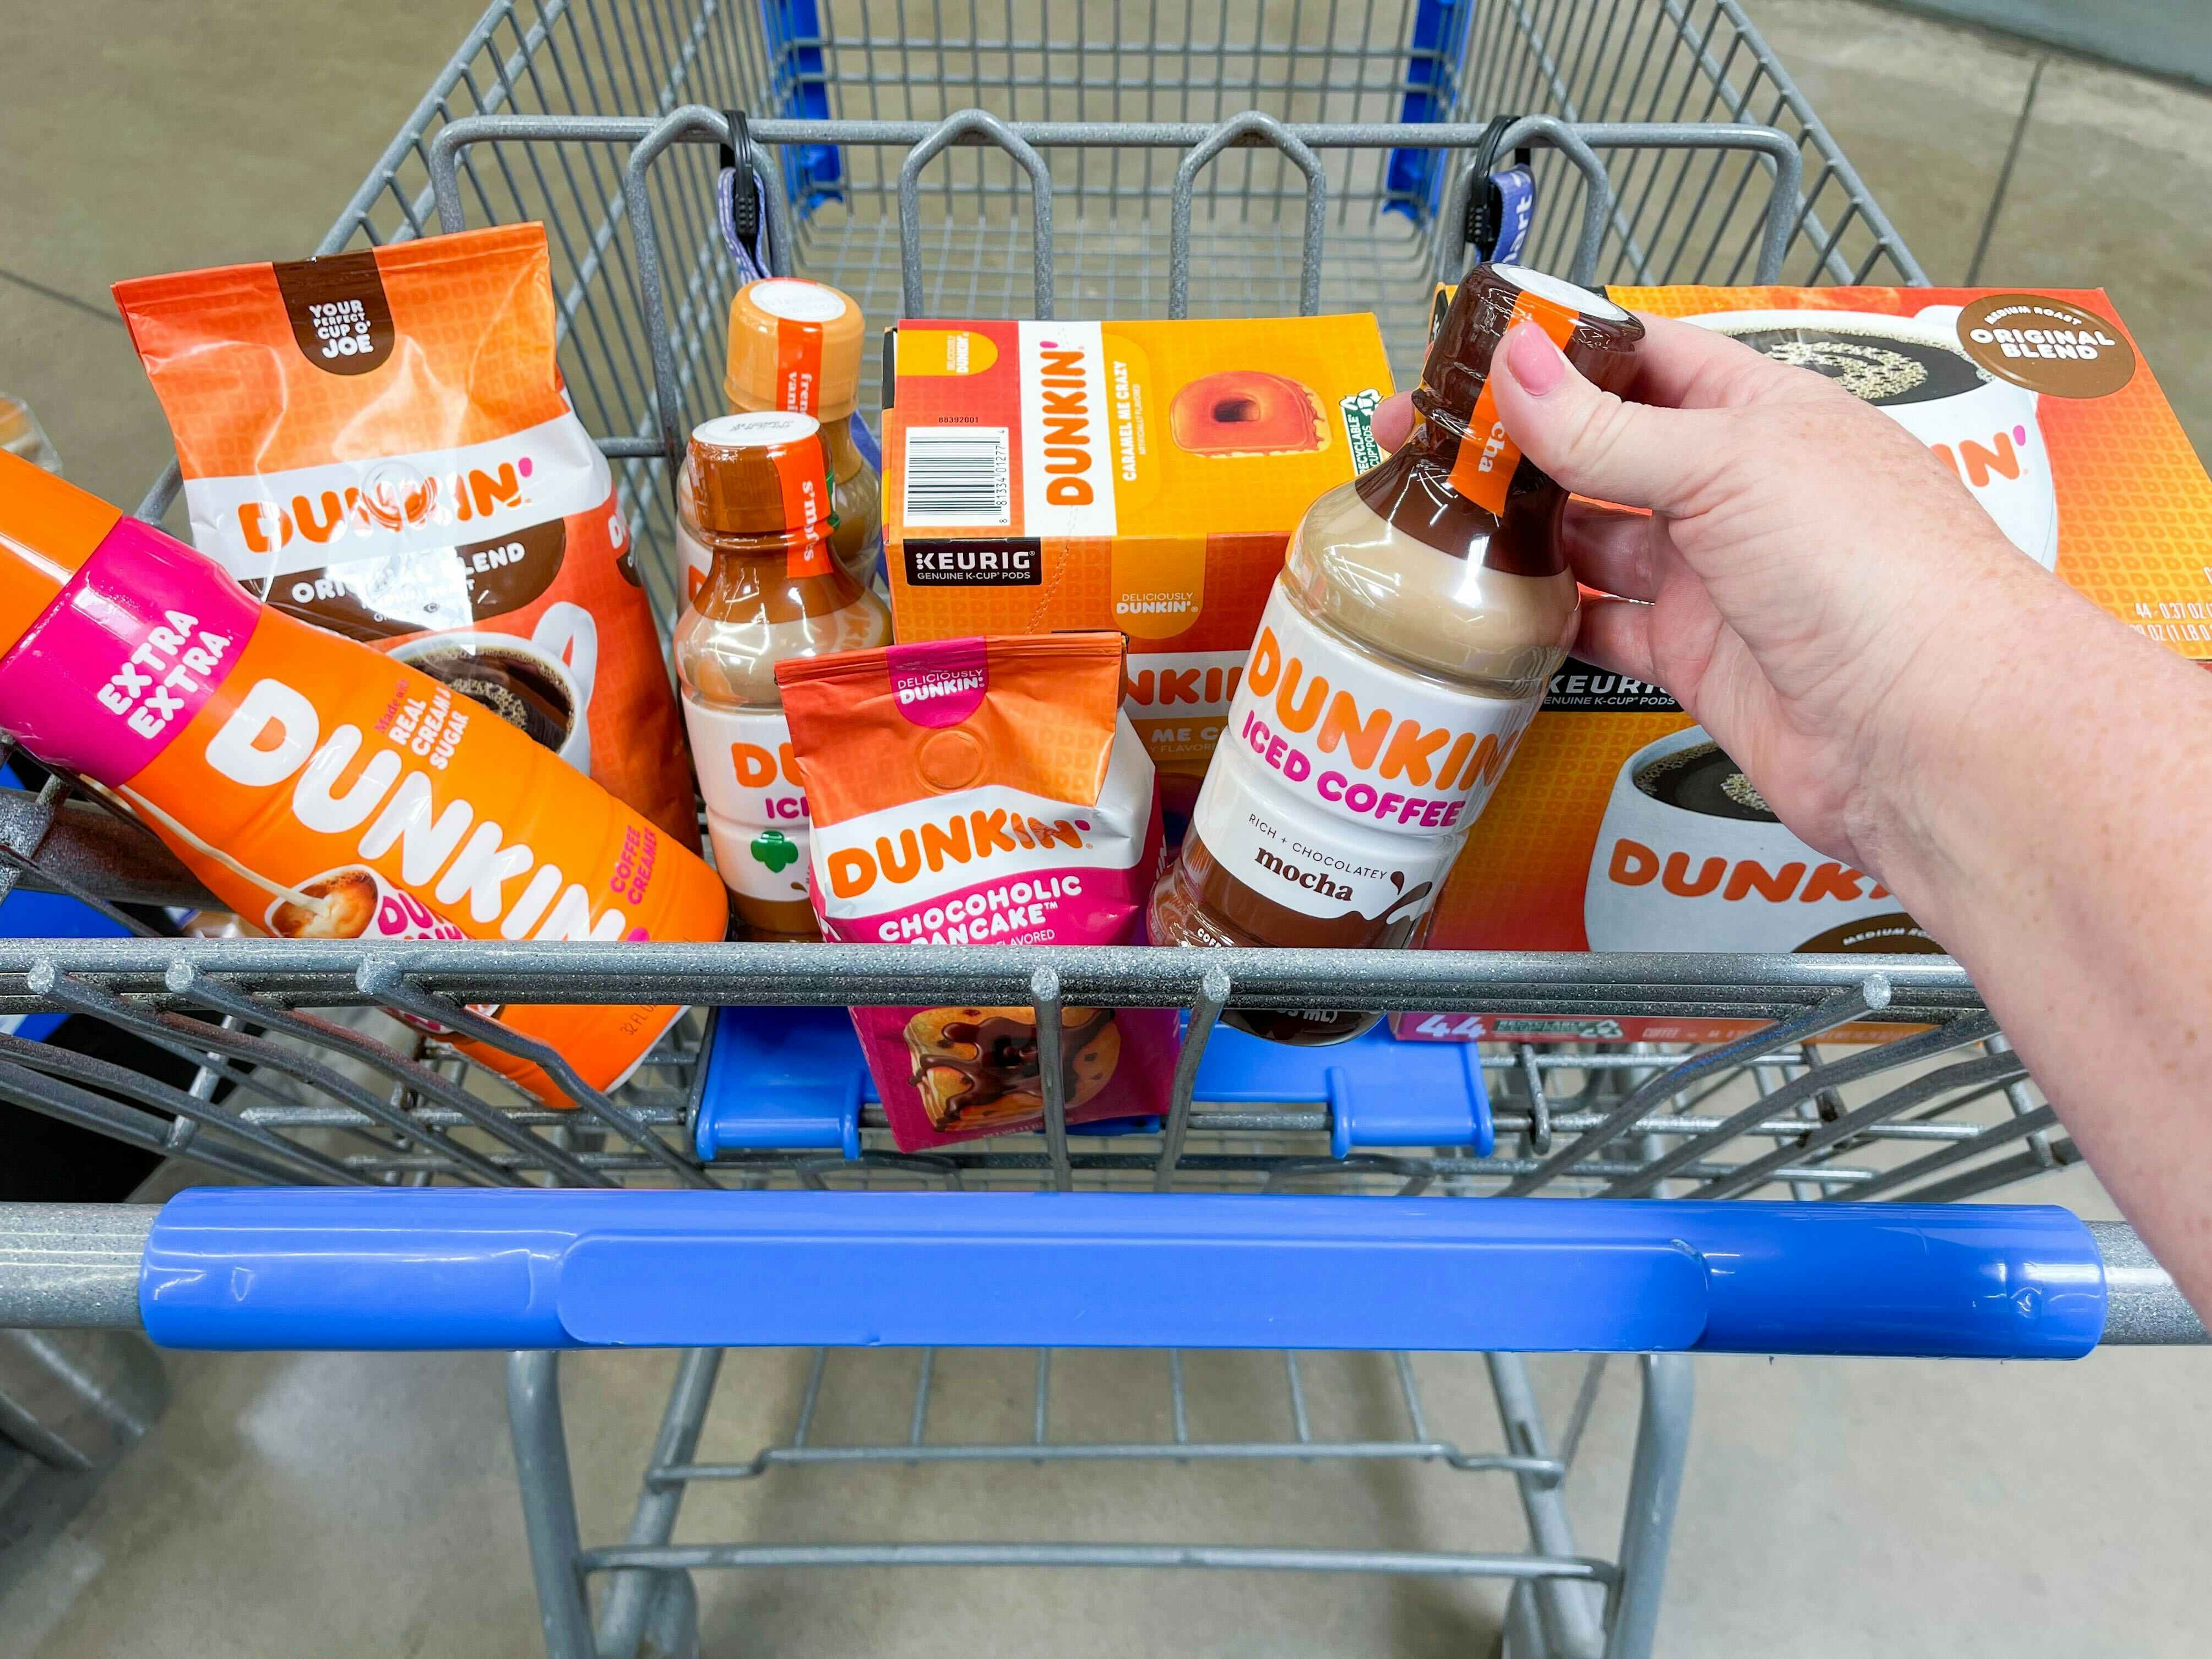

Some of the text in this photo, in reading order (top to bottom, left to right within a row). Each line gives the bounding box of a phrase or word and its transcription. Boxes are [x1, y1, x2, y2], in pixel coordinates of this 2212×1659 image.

[308, 299, 364, 318] YOUR
[313, 312, 366, 328] PERFECT
[1983, 306, 2083, 325] MEDIUM ROAST
[317, 320, 371, 340] CUP O'
[1970, 329, 2116, 346] ORIGINAL
[322, 334, 374, 358] JOE
[2000, 343, 2099, 360] BLEND
[1040, 340, 1094, 505] DUNKIN'
[1113, 361, 1137, 481] CARAMEL ME CRAZY
[1362, 425, 1376, 447] PODS
[995, 445, 1007, 473] 01277
[996, 477, 1007, 505] 81334
[917, 572, 964, 580] GENUINE
[1002, 571, 1031, 579] PODS
[1122, 592, 1193, 602] DELICIOUSLY
[2186, 602, 2208, 619] OZ
[96, 610, 199, 715] EXTRA
[127, 630, 232, 739] EXTRA
[898, 669, 983, 689] DELICIOUSLY
[1639, 697, 1676, 705] PODS
[388, 698, 427, 746] REAL
[411, 695, 451, 756] CREAM
[1151, 728, 1193, 743] ME
[429, 710, 470, 770] SUGAR
[1242, 710, 1466, 828] ICED COFFEE
[609, 825, 641, 894] COFFEE
[828, 808, 1094, 899] DUNKIN'
[1248, 813, 1277, 839] RICH
[1292, 842, 1388, 880] CHOCOLATEY
[626, 826, 657, 905] CREAMER
[1254, 847, 1354, 901] mocha
[1607, 837, 1892, 903] DUNK
[878, 875, 1082, 942] CHOCOHOLIC
[620, 1022, 638, 1036] 32
[629, 1013, 649, 1026] FL
[1416, 1014, 1486, 1038] 44
